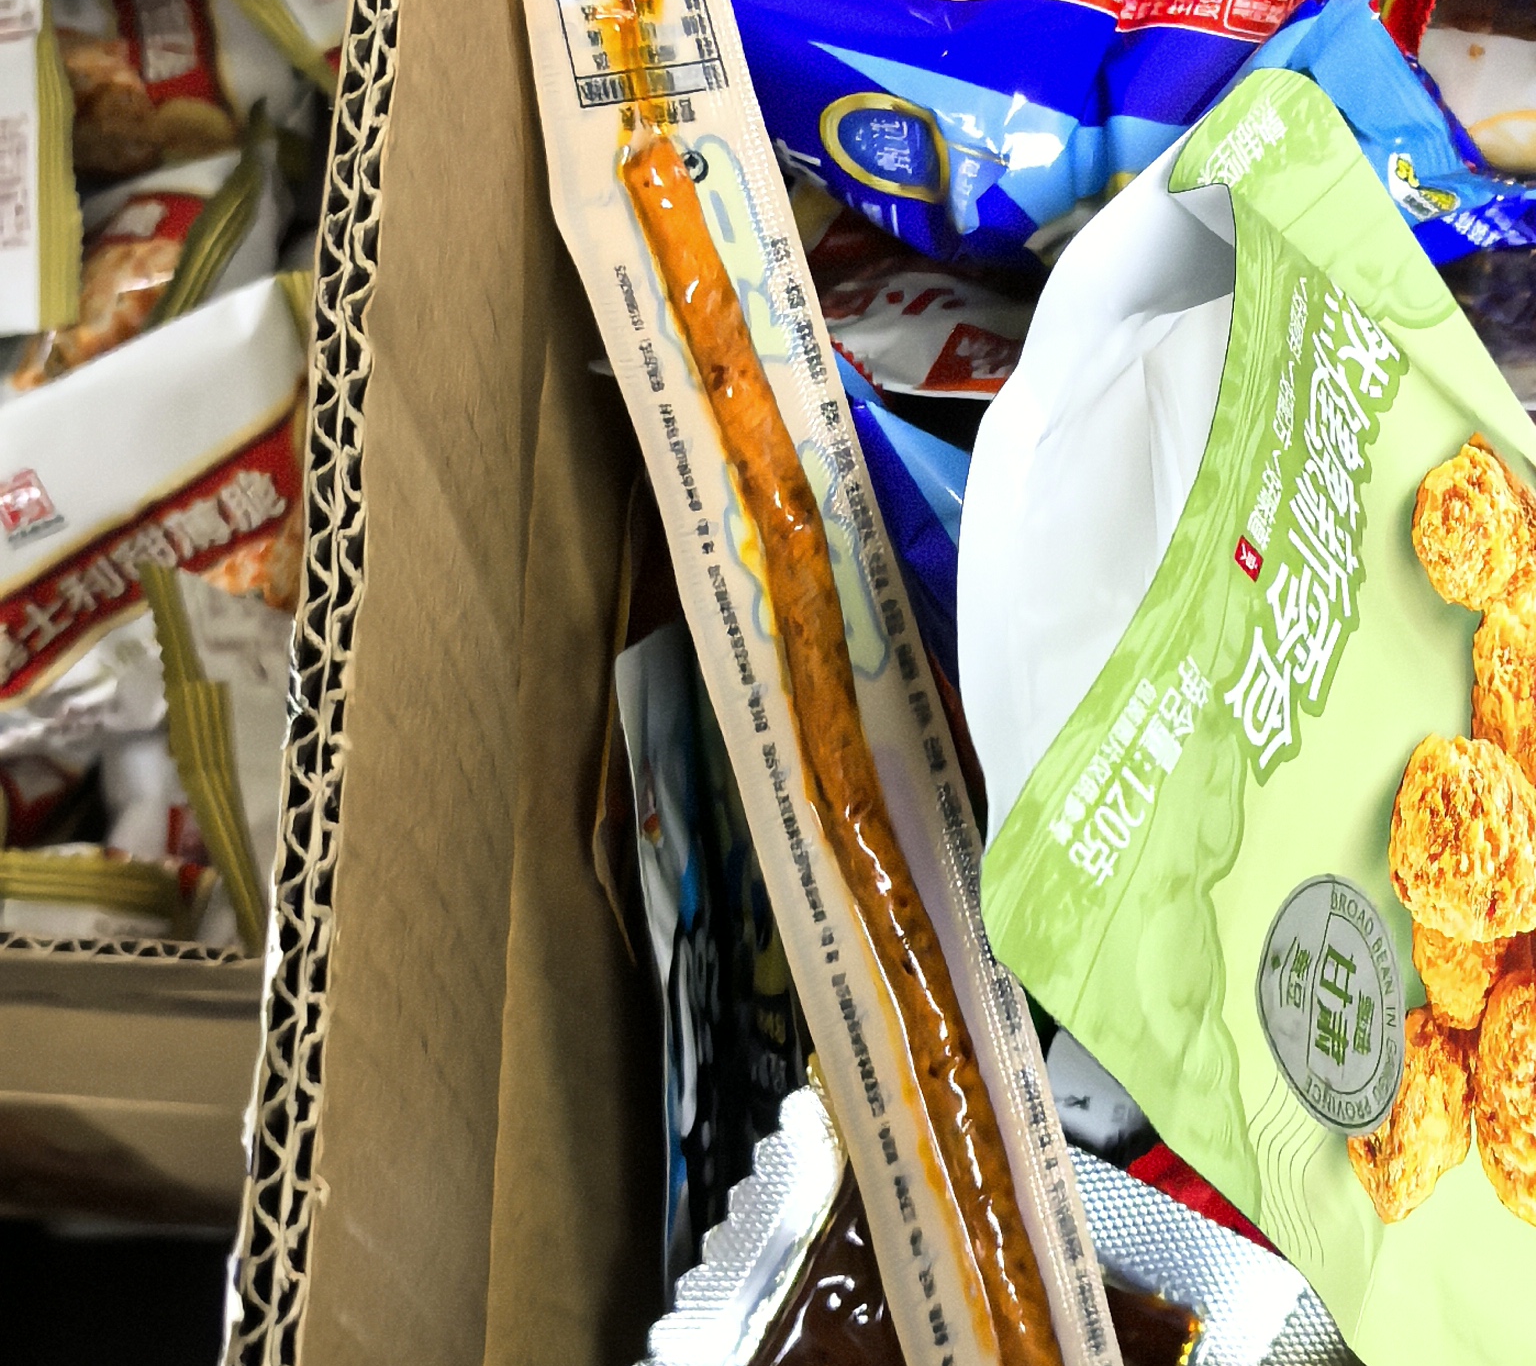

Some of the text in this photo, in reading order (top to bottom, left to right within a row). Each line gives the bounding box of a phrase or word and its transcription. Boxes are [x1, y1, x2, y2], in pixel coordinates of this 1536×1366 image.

[1331, 889, 1374, 936] BROAD
[1371, 937, 1394, 997] BEAN
[1315, 944, 1357, 1066] 甘肃
